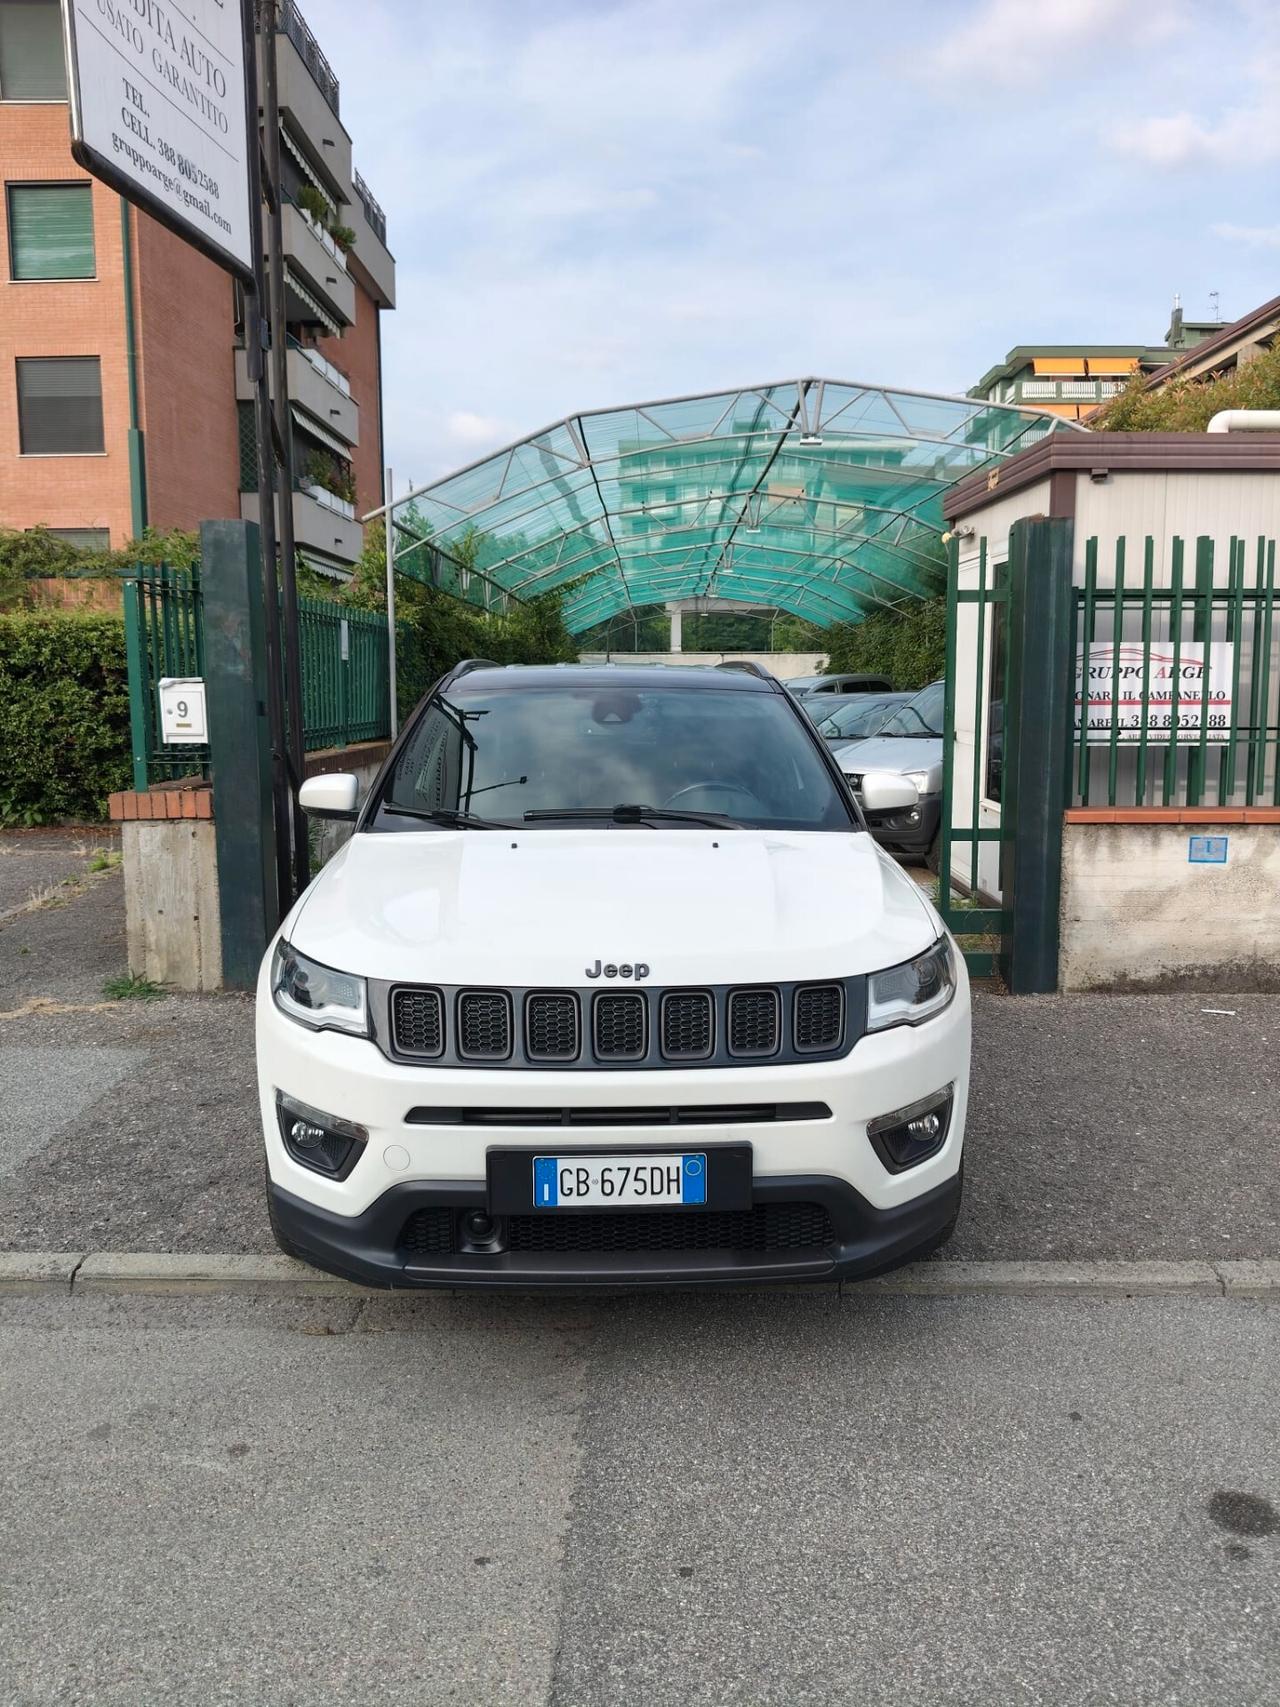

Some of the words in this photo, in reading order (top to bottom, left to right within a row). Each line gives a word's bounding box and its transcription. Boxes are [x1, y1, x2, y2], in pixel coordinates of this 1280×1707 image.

[180, 35, 227, 98] AUTO
[122, 77, 150, 118] TEL.
[152, 47, 229, 134] GARANTITO
[121, 107, 156, 150] CELL.
[157, 137, 177, 168] 388
[111, 132, 232, 235] gruppoarge@gmail.com
[176, 700, 188, 718] 9
[1123, 691, 1136, 700] IL
[1139, 691, 1226, 700] CAMANELO
[1131, 714, 1158, 727] 38
[1162, 714, 1226, 727] 85288
[585, 959, 650, 981] Jeep
[559, 1167, 590, 1197] GB
[600, 1165, 681, 1197] 675DH
